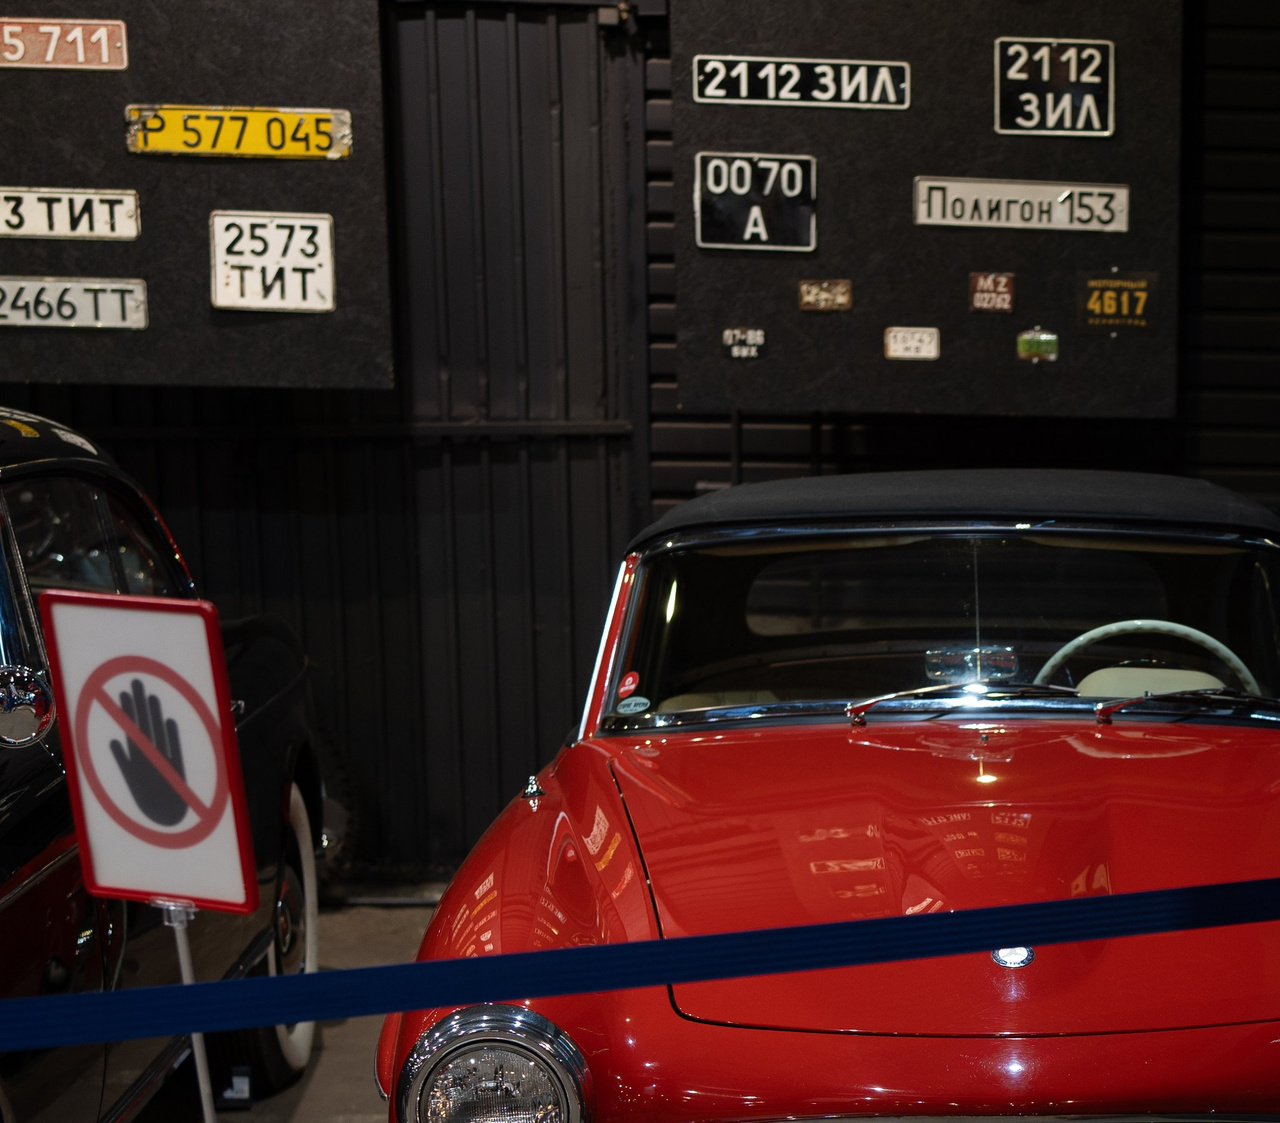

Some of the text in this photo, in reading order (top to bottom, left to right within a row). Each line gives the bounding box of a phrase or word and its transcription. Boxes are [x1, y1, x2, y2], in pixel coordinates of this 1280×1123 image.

[39, 27, 109, 63] 711
[811, 65, 897, 102] ЗИЛ
[1015, 93, 1101, 129] ЗИЛ
[183, 115, 248, 149] 577
[267, 117, 333, 151] 045
[37, 197, 124, 233] ТИТ
[925, 186, 1116, 225] Полигон 153
[223, 222, 319, 258] 2573
[230, 265, 316, 301] ТИТ
[83, 288, 135, 322] ТТ
[1087, 290, 1148, 315] 4617
